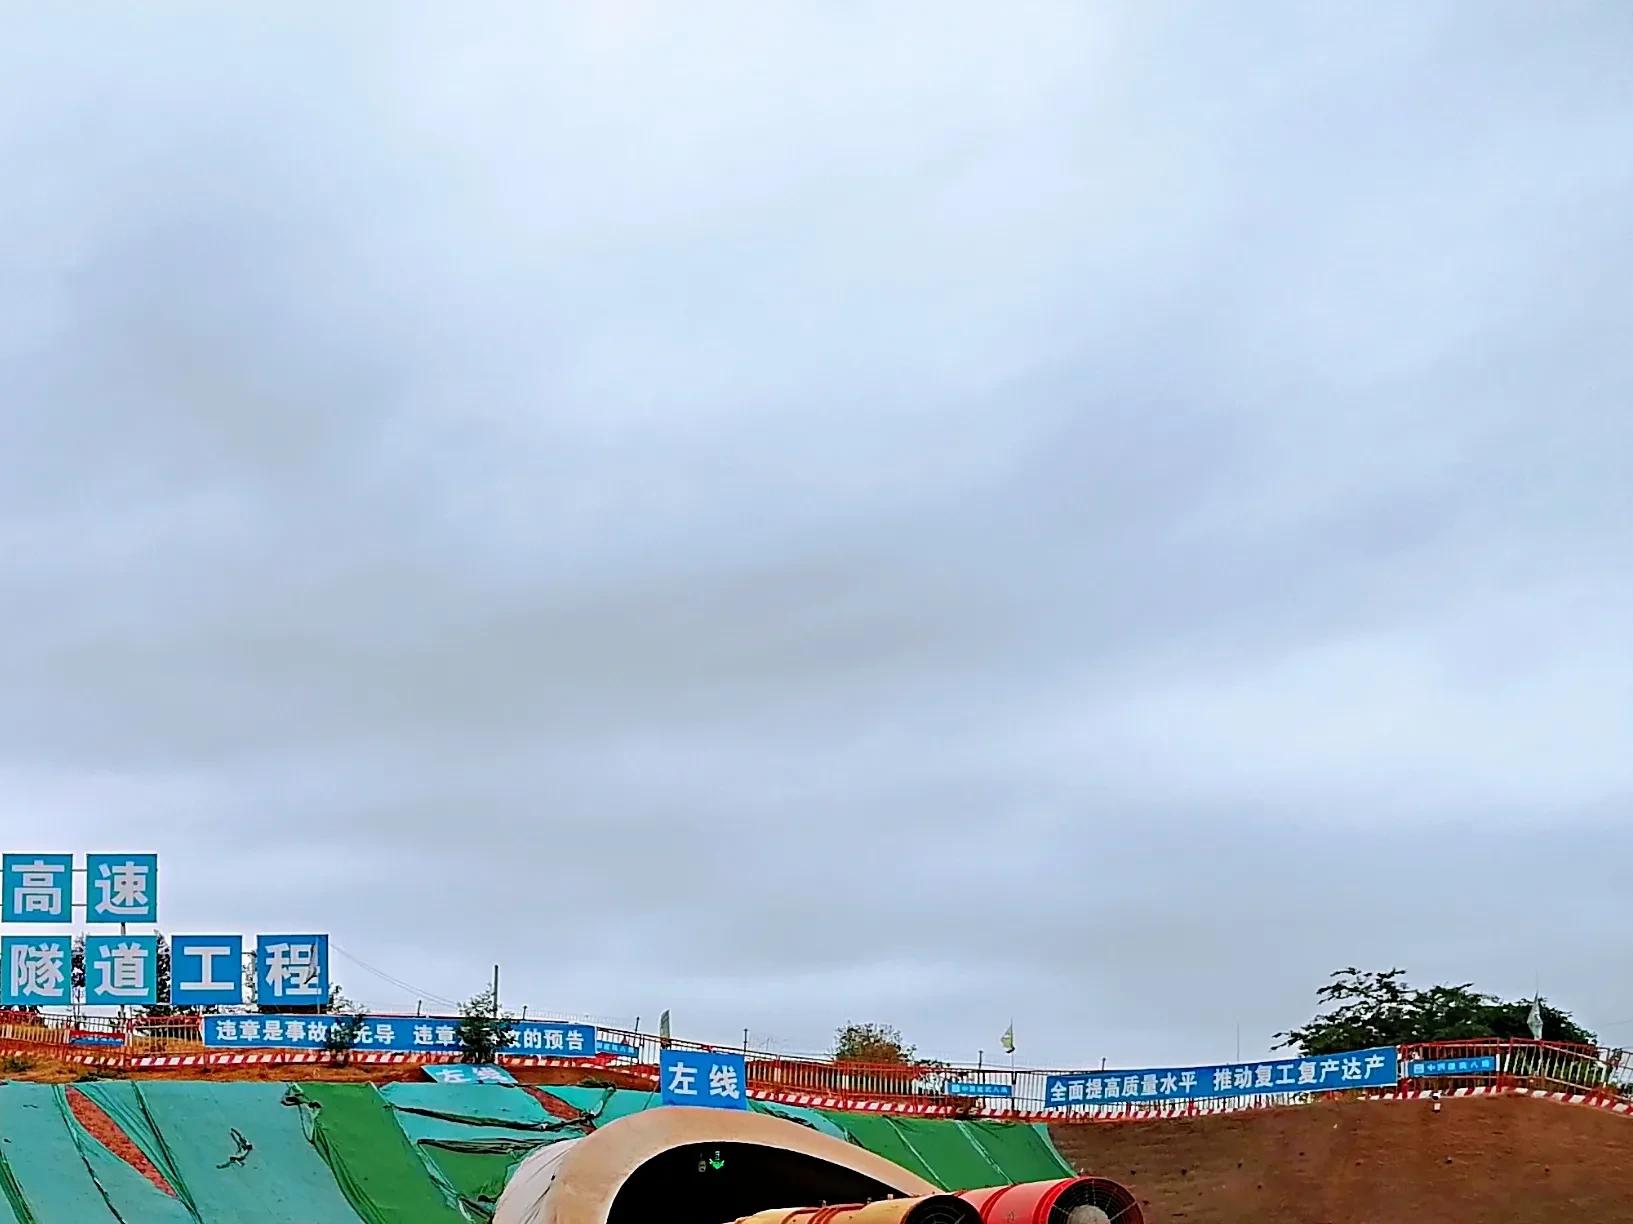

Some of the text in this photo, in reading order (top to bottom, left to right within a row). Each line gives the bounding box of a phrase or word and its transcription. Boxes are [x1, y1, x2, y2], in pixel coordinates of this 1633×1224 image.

[668, 1061, 741, 1099] 左线
[1050, 1053, 1386, 1103] 全面提高质量水平 推动复工复产达产
